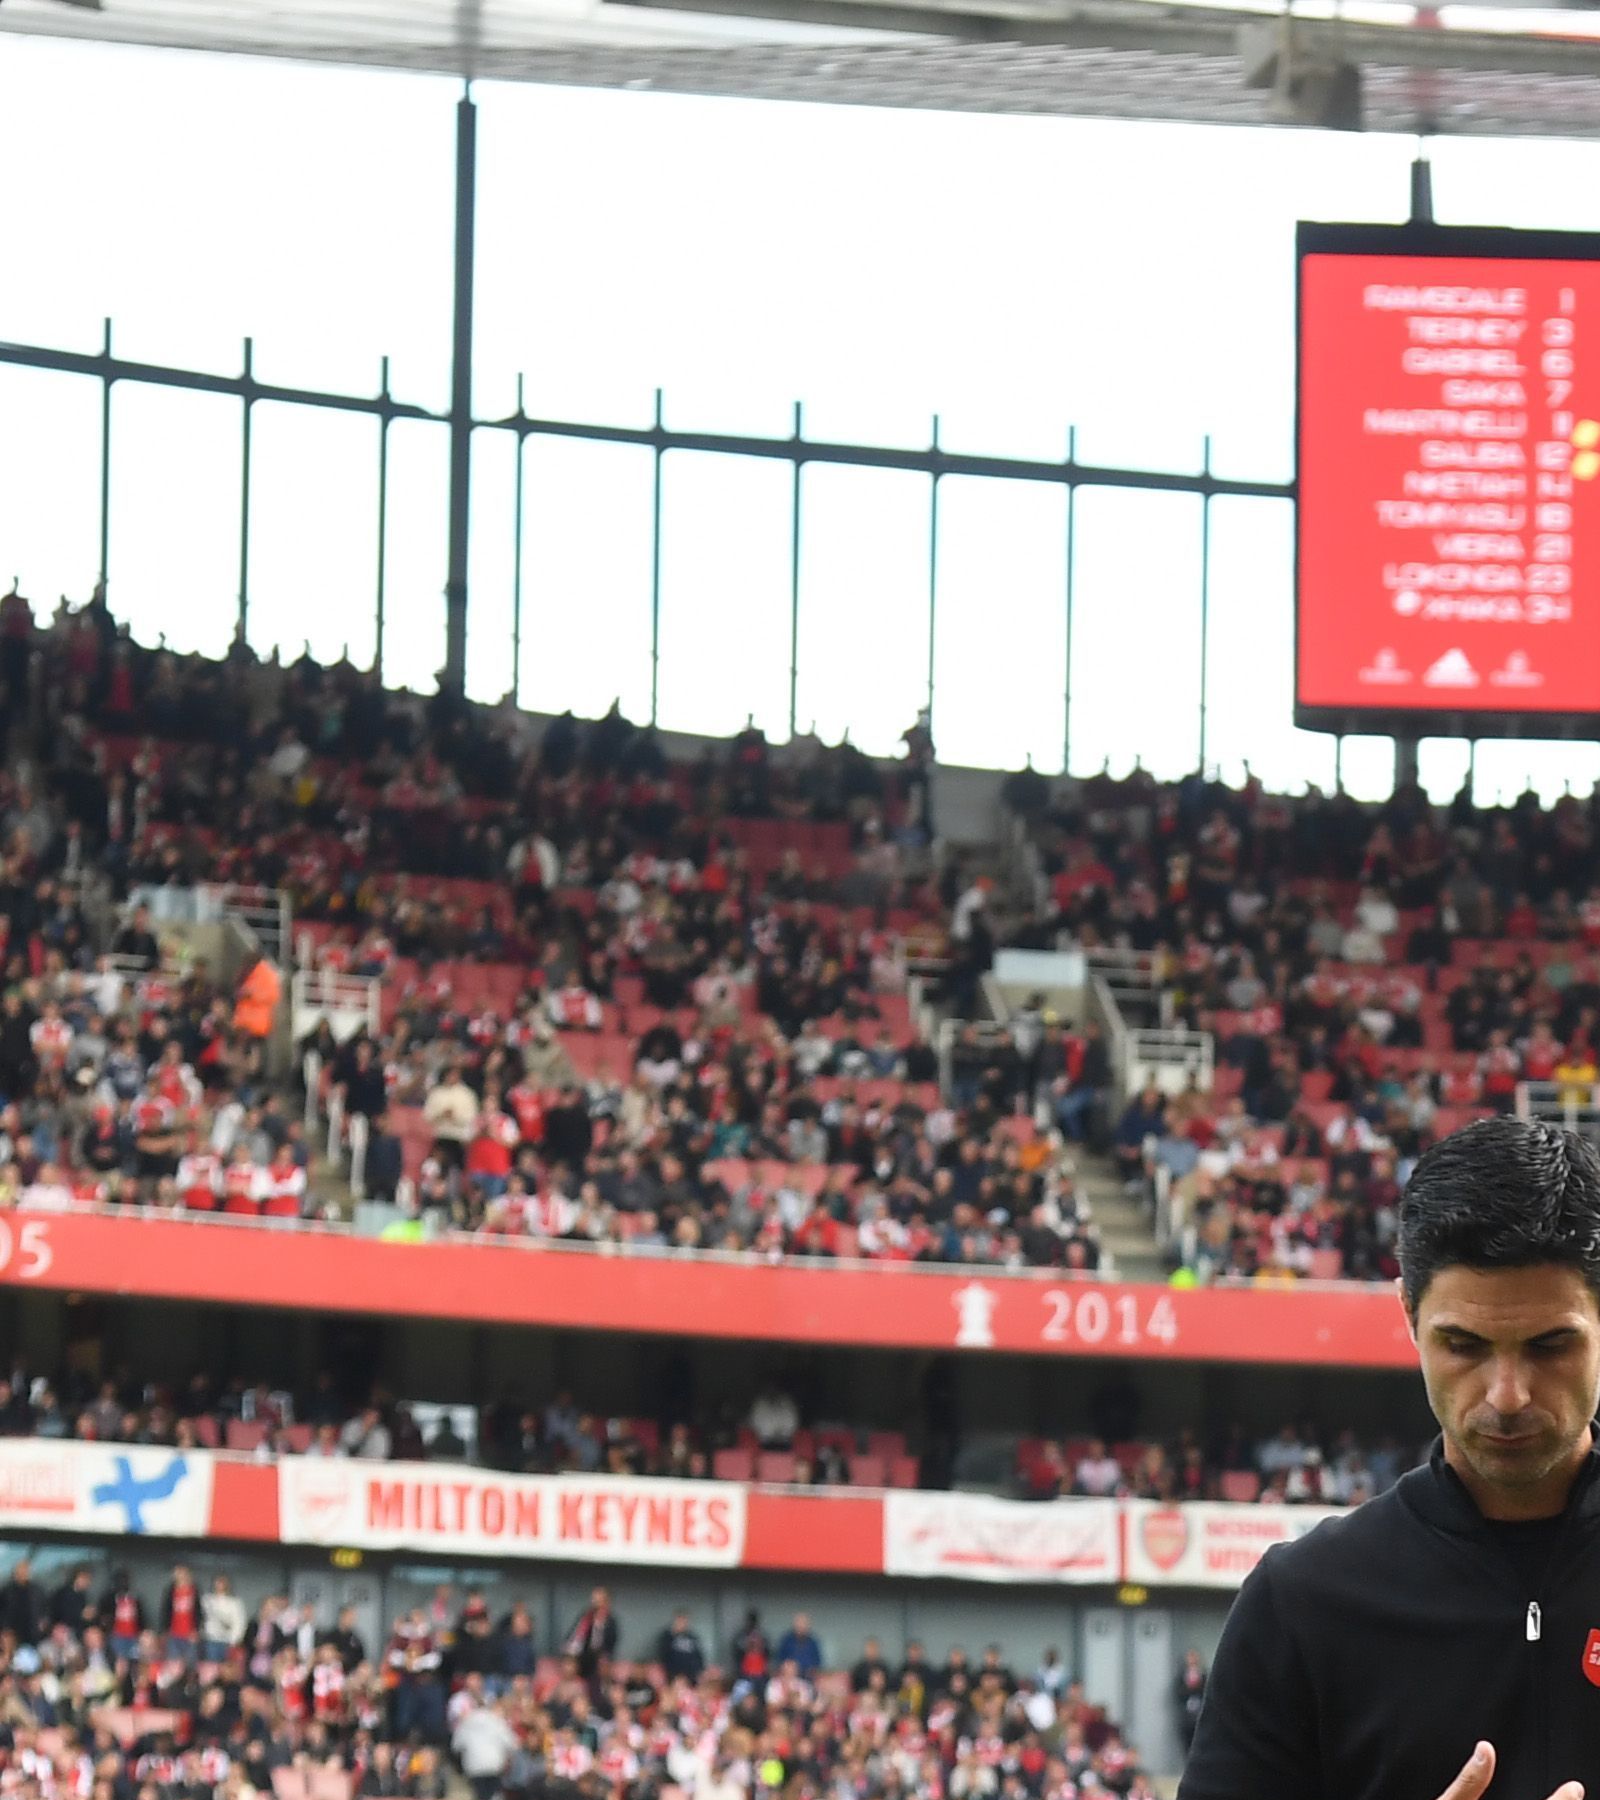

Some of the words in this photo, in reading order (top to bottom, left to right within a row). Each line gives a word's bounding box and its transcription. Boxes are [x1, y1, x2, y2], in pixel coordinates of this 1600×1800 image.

[1542, 318, 1574, 347] 3
[1541, 349, 1574, 377] 6
[1547, 379, 1573, 406] 7
[1041, 1288, 1179, 1346] 2014
[367, 1479, 541, 1538] MILTON
[559, 1490, 730, 1548] KEYNES
